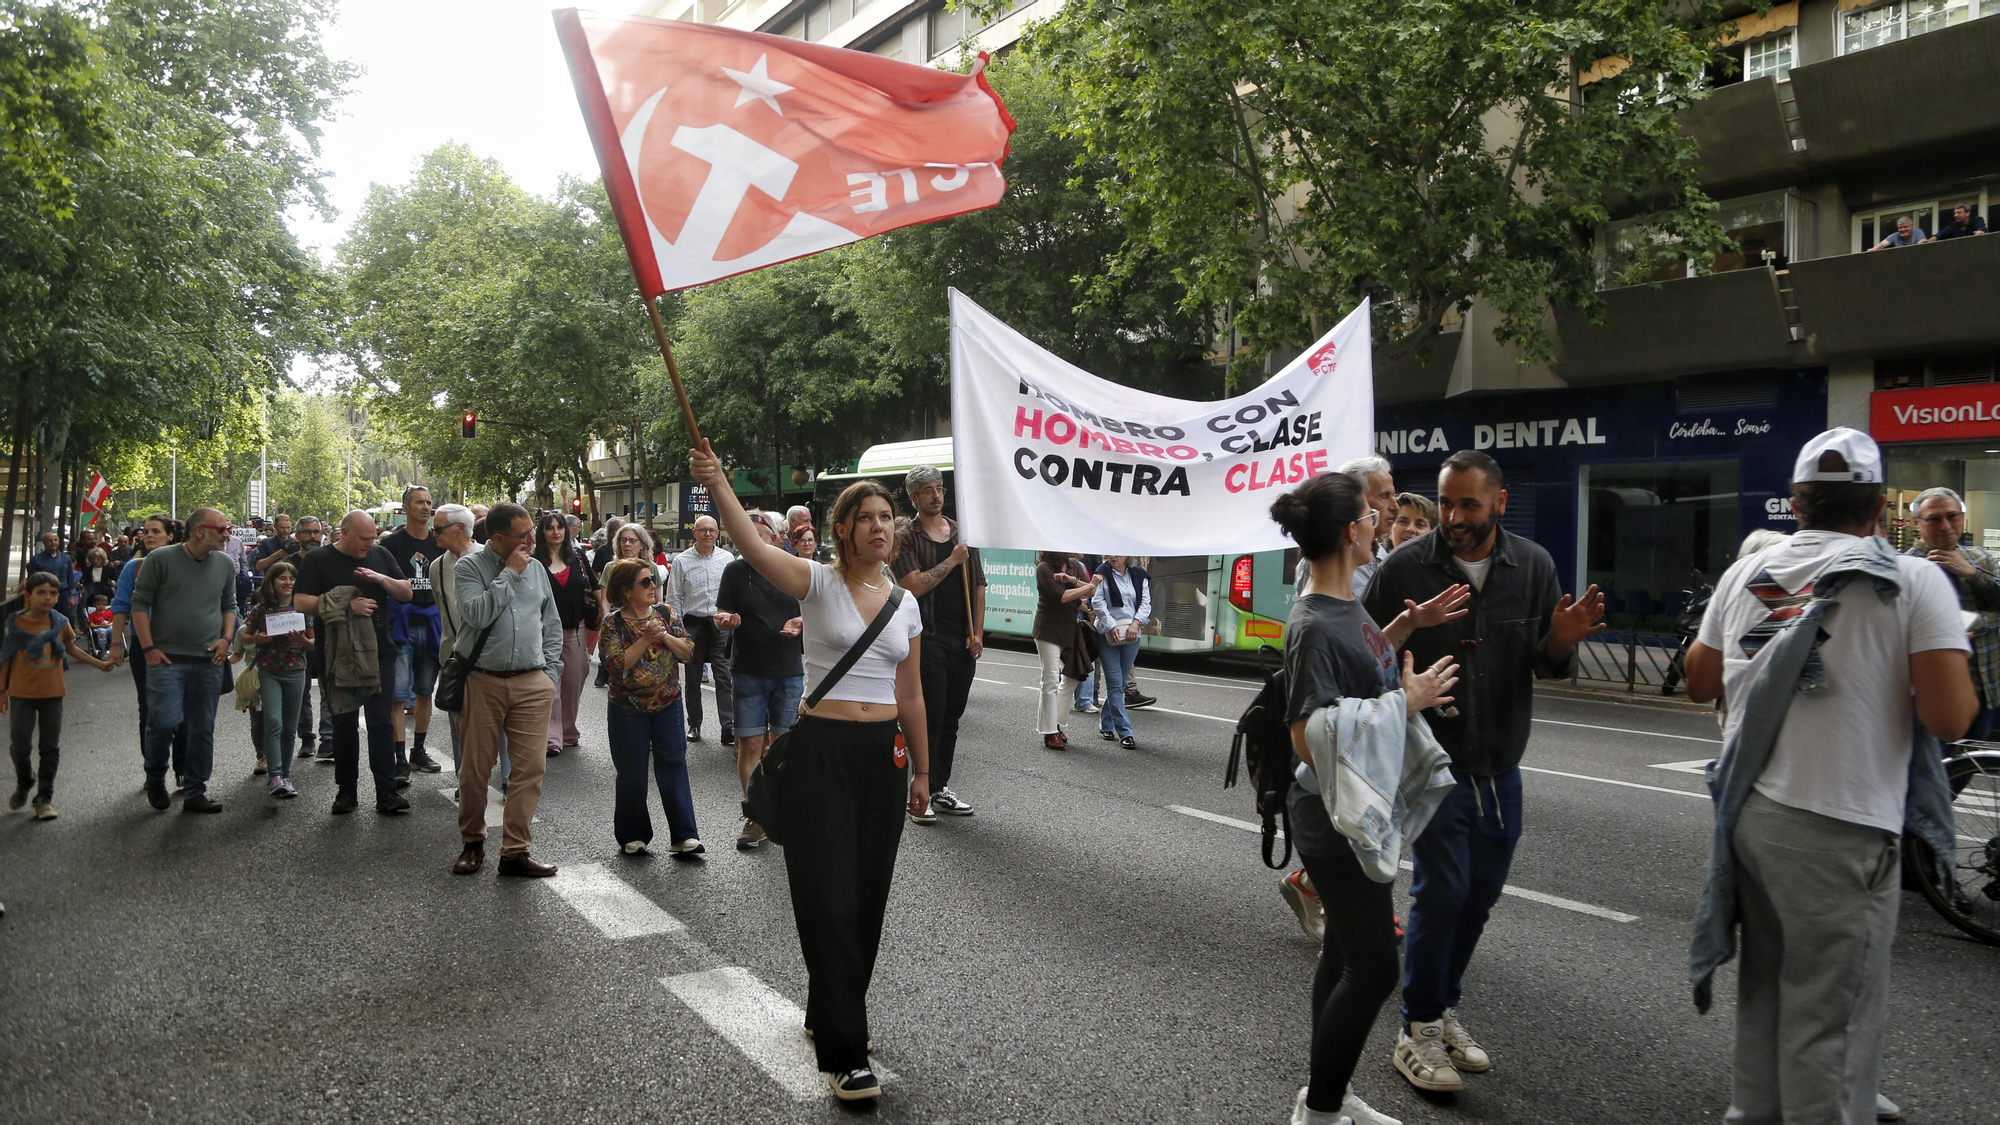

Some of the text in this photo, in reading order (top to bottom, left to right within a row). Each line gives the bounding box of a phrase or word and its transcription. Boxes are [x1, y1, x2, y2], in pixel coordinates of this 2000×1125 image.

[1312, 363, 1337, 376] PCTE
[1206, 389, 1301, 433] CON
[1220, 411, 1323, 455] CLASE
[1474, 417, 1606, 450] DENTAL
[1013, 447, 1331, 496] CONTRA CLASE
[691, 484, 708, 494] IRÁN
[984, 558, 1008, 576] buen
[1009, 563, 1035, 577] trato
[990, 581, 1034, 600] empatía.
